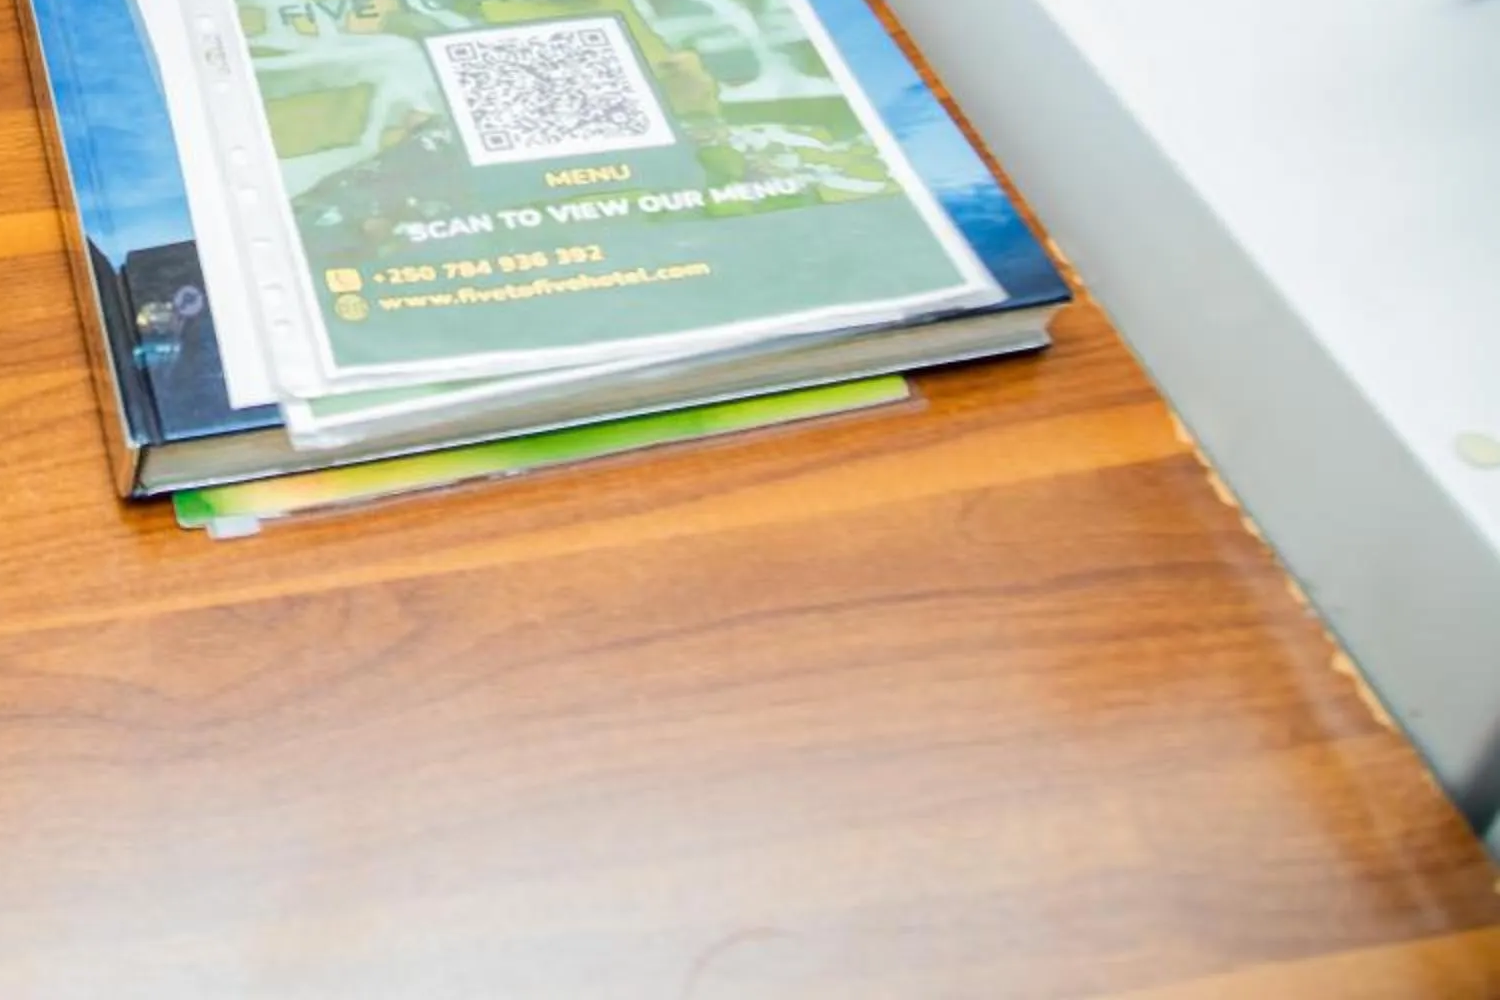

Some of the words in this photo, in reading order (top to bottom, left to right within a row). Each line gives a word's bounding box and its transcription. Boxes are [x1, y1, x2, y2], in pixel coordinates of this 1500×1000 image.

[545, 164, 631, 188] MENU
[407, 213, 494, 243] SCAN
[498, 209, 542, 230] TO
[547, 197, 630, 223] VIEW
[638, 189, 706, 213] OUR
[708, 178, 799, 204] MENU
[372, 265, 436, 284] +250
[441, 259, 492, 279] 784
[380, 260, 711, 311] www.fivetofivehotel.com
